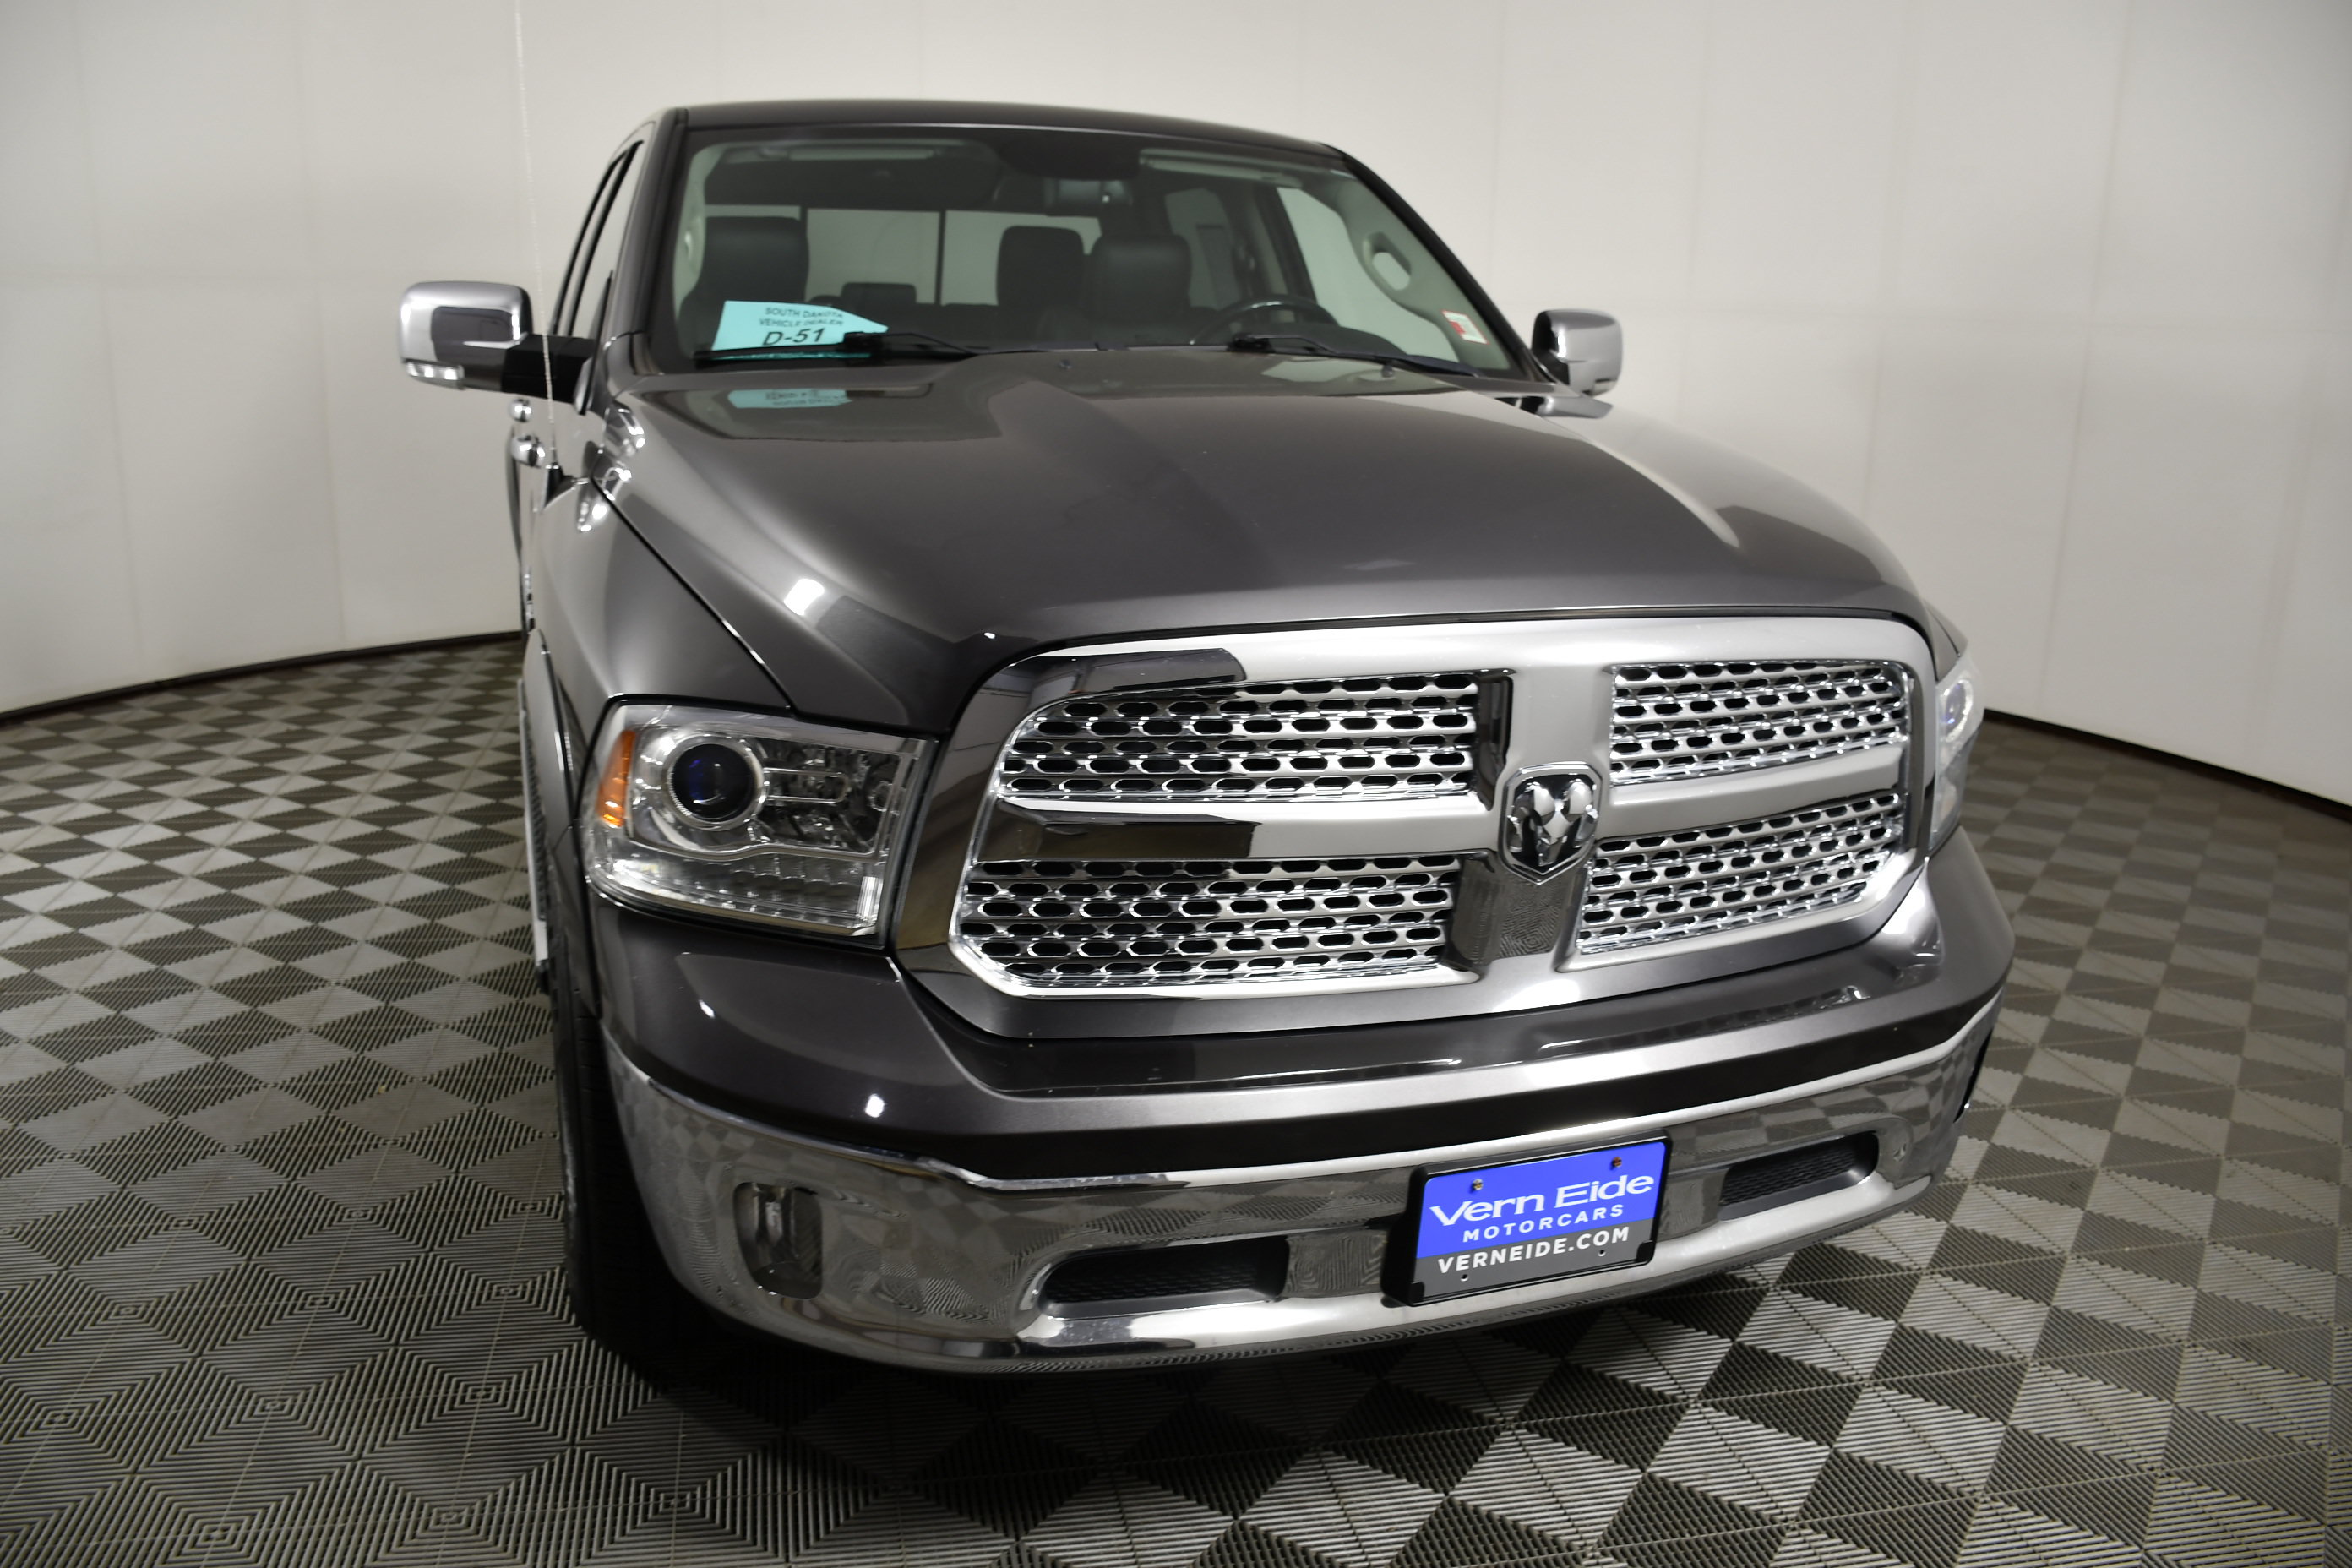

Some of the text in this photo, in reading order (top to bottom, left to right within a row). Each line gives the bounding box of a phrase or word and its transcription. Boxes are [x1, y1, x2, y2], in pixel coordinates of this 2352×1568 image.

[760, 318, 801, 328] VEHICLE
[765, 308, 801, 318] SOUTH
[762, 328, 825, 346] D-51
[1429, 1174, 1654, 1226] Vern Eide
[1462, 1204, 1624, 1243] MOTORCARS
[1438, 1226, 1630, 1274] VERNEIDE.COM
